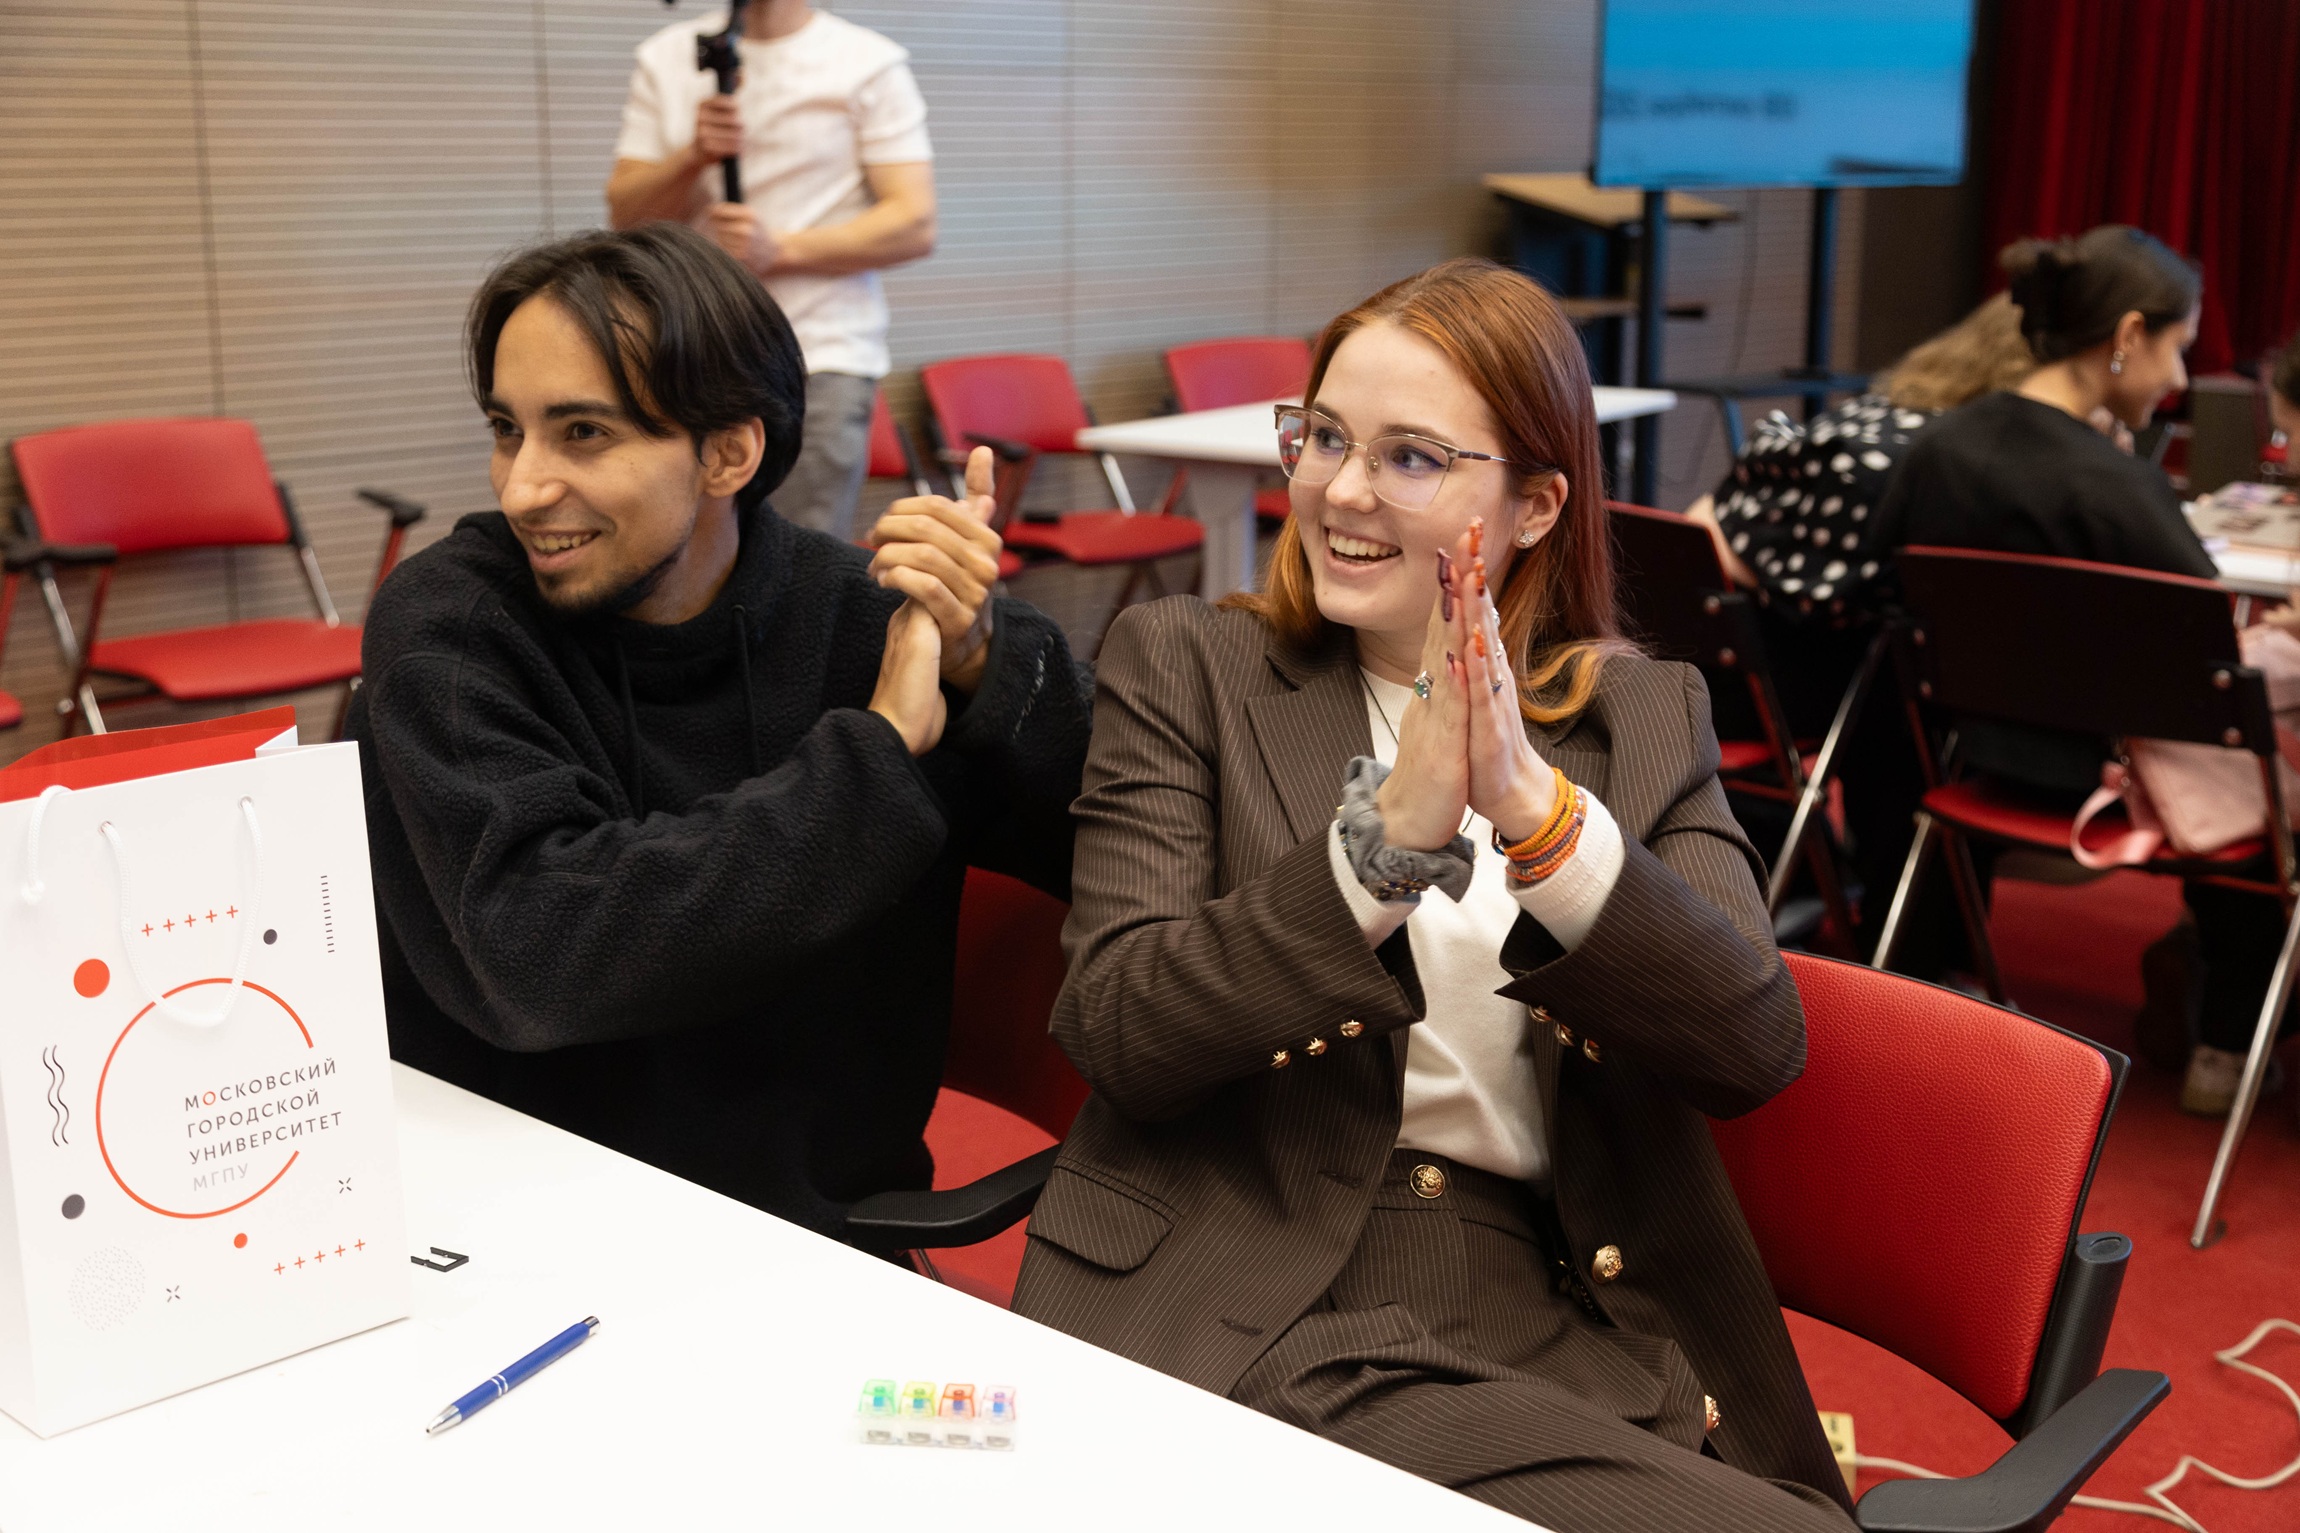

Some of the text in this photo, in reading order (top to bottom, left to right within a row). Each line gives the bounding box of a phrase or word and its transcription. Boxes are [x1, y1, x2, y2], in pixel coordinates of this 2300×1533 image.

[185, 1057, 336, 1111] МОСКОВСКИЙ
[187, 1088, 320, 1138] ГОРОДСКОЙ
[189, 1111, 342, 1165] УНИВЕРСИТЕТ
[193, 1163, 249, 1191] МГПУ
